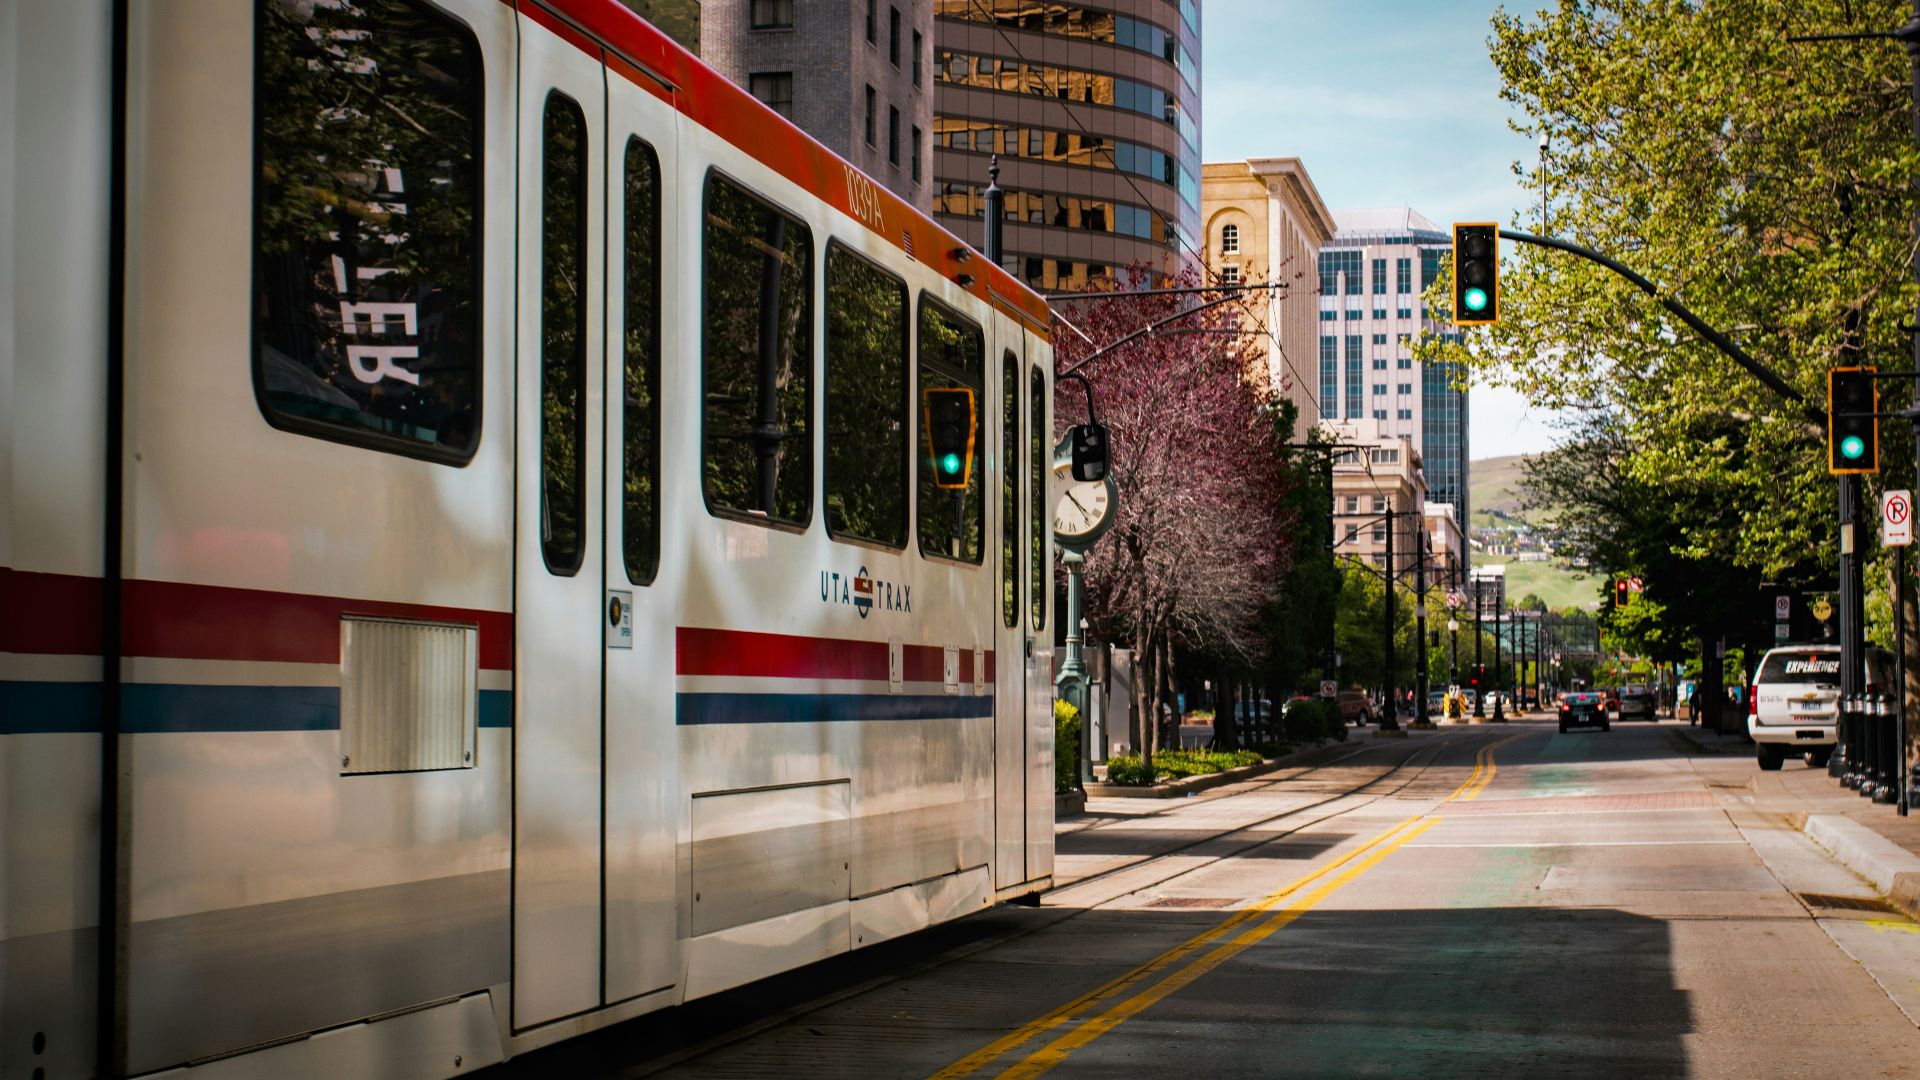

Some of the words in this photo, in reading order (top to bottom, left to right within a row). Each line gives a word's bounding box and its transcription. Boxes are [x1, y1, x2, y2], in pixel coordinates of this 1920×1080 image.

[843, 165, 885, 233] 1039A
[821, 570, 850, 604] UTA
[876, 581, 911, 613] TRAX
[1785, 660, 1840, 673] EXPERIENCE
